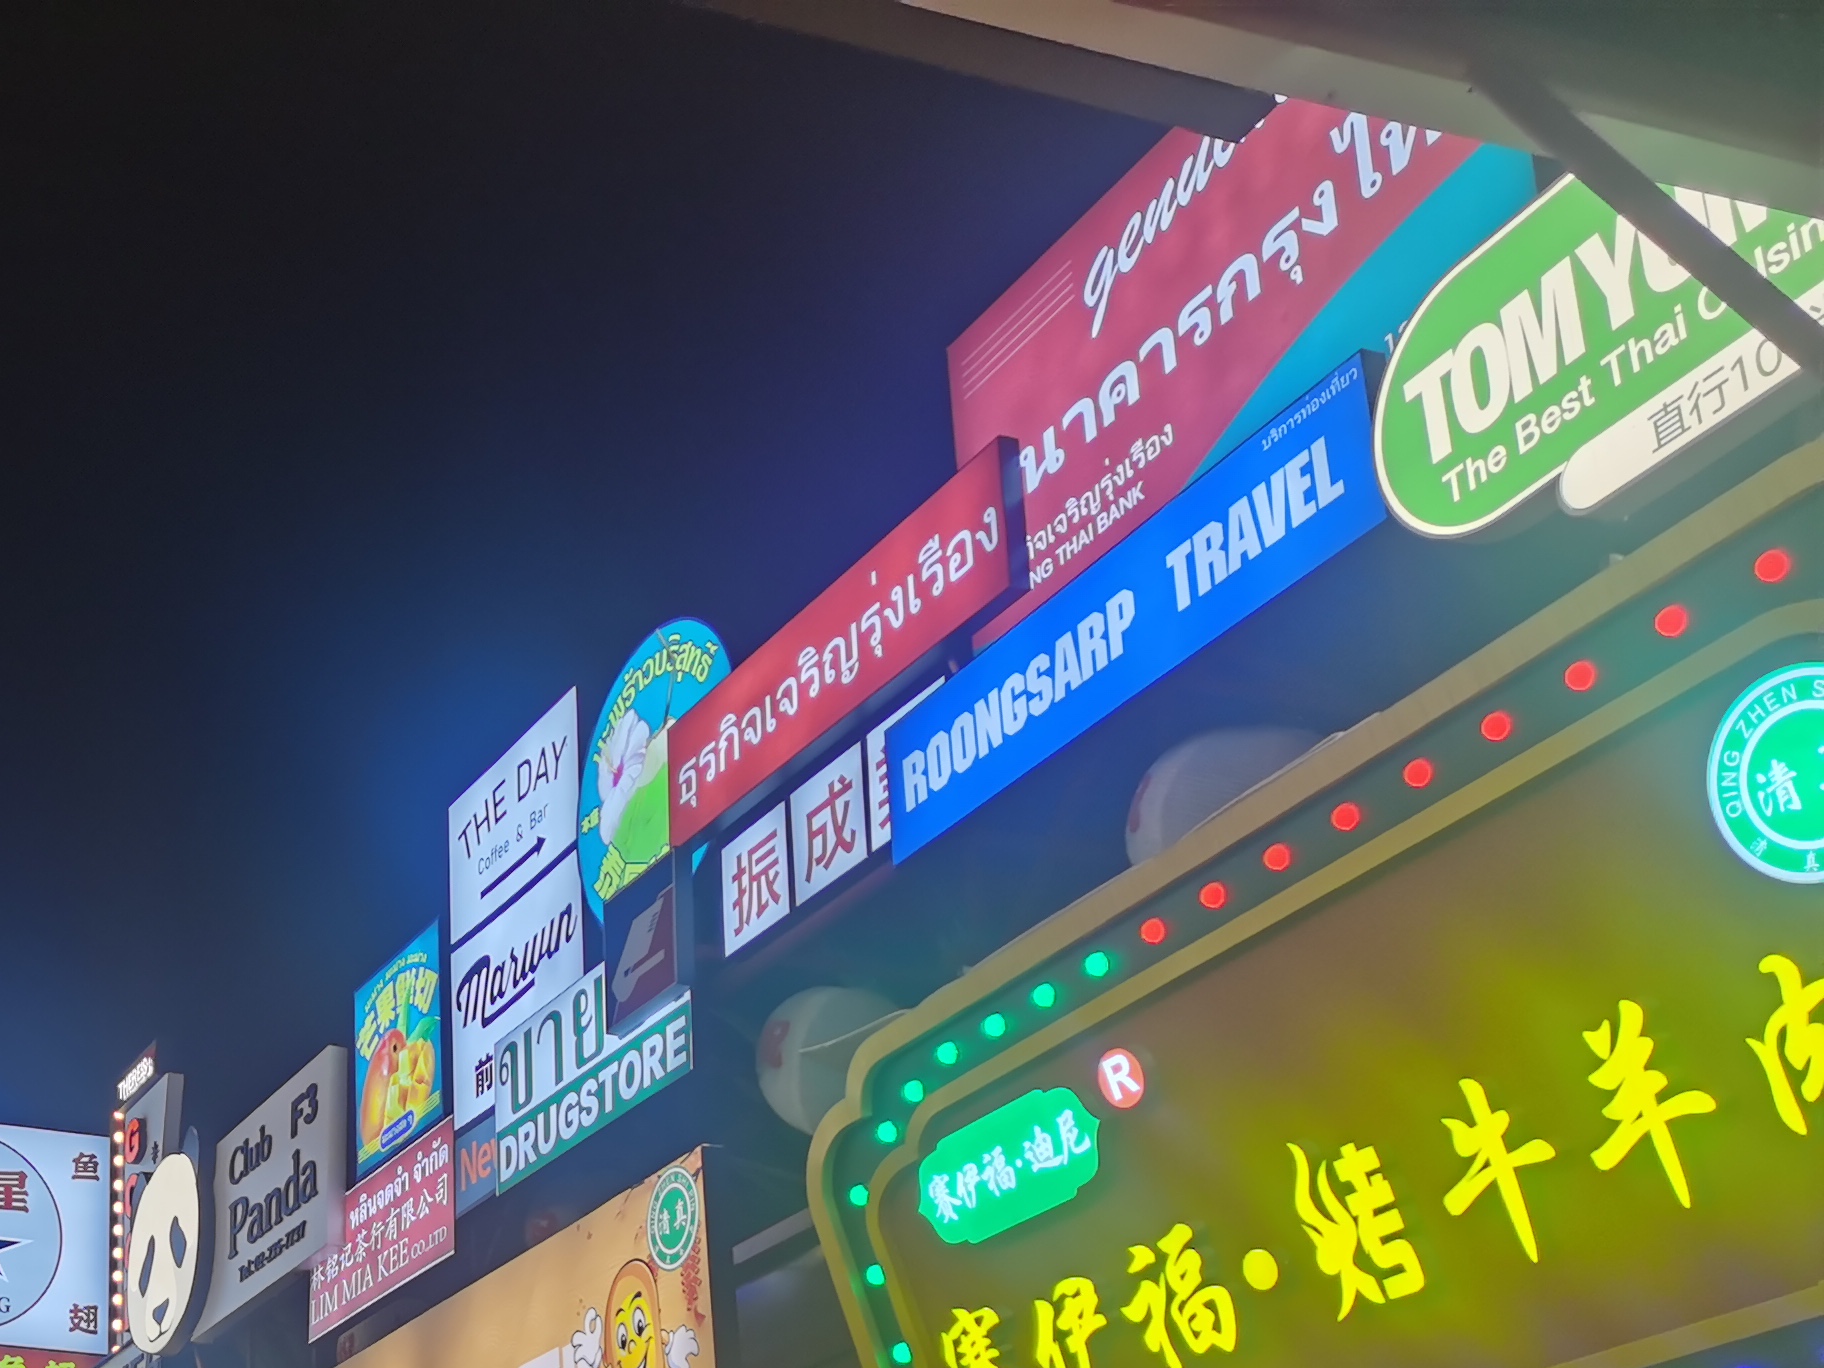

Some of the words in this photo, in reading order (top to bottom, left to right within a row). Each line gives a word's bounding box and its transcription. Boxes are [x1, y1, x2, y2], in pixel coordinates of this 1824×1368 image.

[1442, 438, 1508, 503] The
[1515, 375, 1596, 456] Best
[1600, 305, 1688, 389] Thai
[1647, 340, 1786, 455] 直行10
[1029, 555, 1054, 590] NG
[1055, 524, 1094, 567] THAI
[1096, 480, 1146, 535] BANK
[903, 587, 1136, 813] ROONGSARP
[1165, 434, 1346, 613] TRAVEL
[457, 777, 508, 861] THE
[514, 735, 569, 801] DAY
[1721, 749, 1742, 819] QING
[1735, 682, 1798, 740] ZHEN
[477, 836, 511, 877] Coffee
[516, 823, 524, 842] &
[529, 803, 549, 831] Bar
[229, 1124, 273, 1186] Club
[497, 1015, 689, 1184] DRUGSTORE
[228, 1148, 319, 1261] Panda
[310, 1290, 338, 1326] LIM
[341, 1264, 374, 1306] MIA
[377, 1237, 410, 1282] KEE
